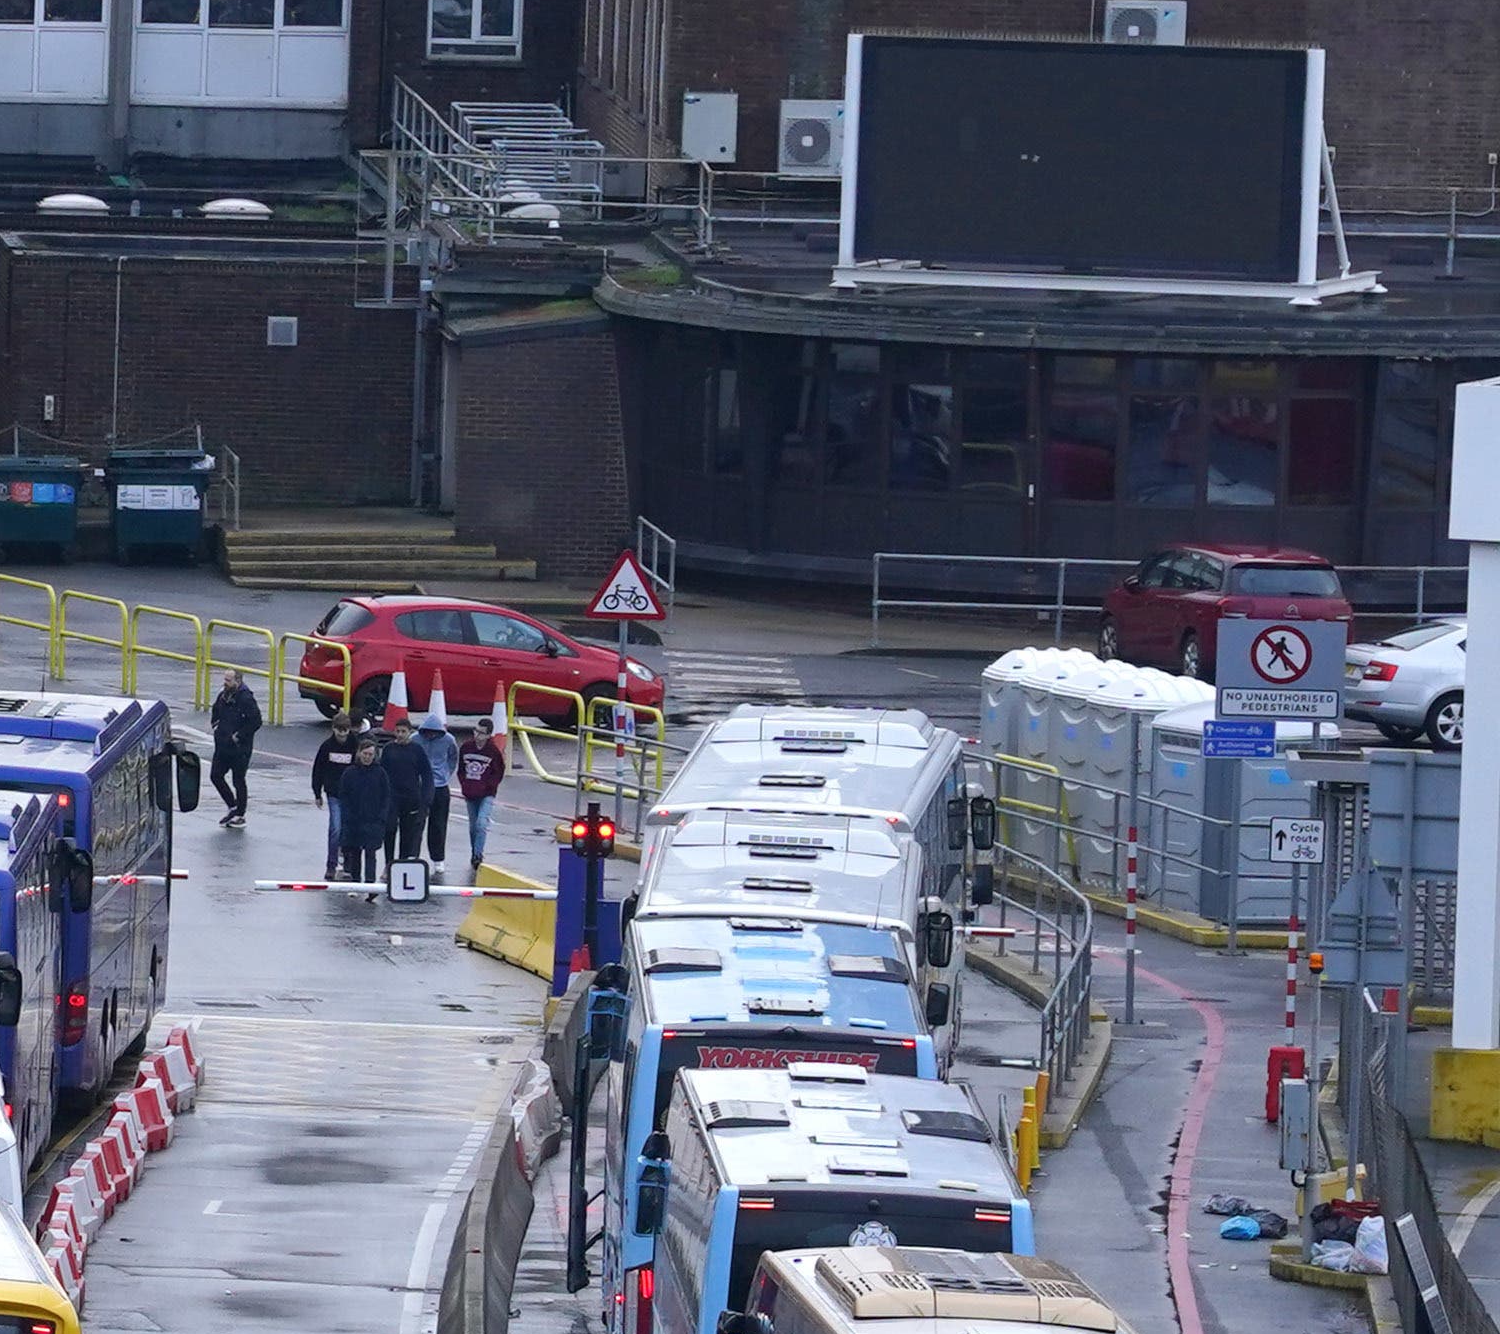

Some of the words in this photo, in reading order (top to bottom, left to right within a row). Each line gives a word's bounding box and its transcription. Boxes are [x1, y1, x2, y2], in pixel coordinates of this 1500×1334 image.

[1226, 691, 1242, 703] NO
[1245, 692, 1334, 705] UNAUTHORISED
[1241, 702, 1318, 715] PEDESTRIANS
[1290, 822, 1321, 835] Cycle
[1290, 834, 1319, 845] route
[402, 872, 415, 891] L
